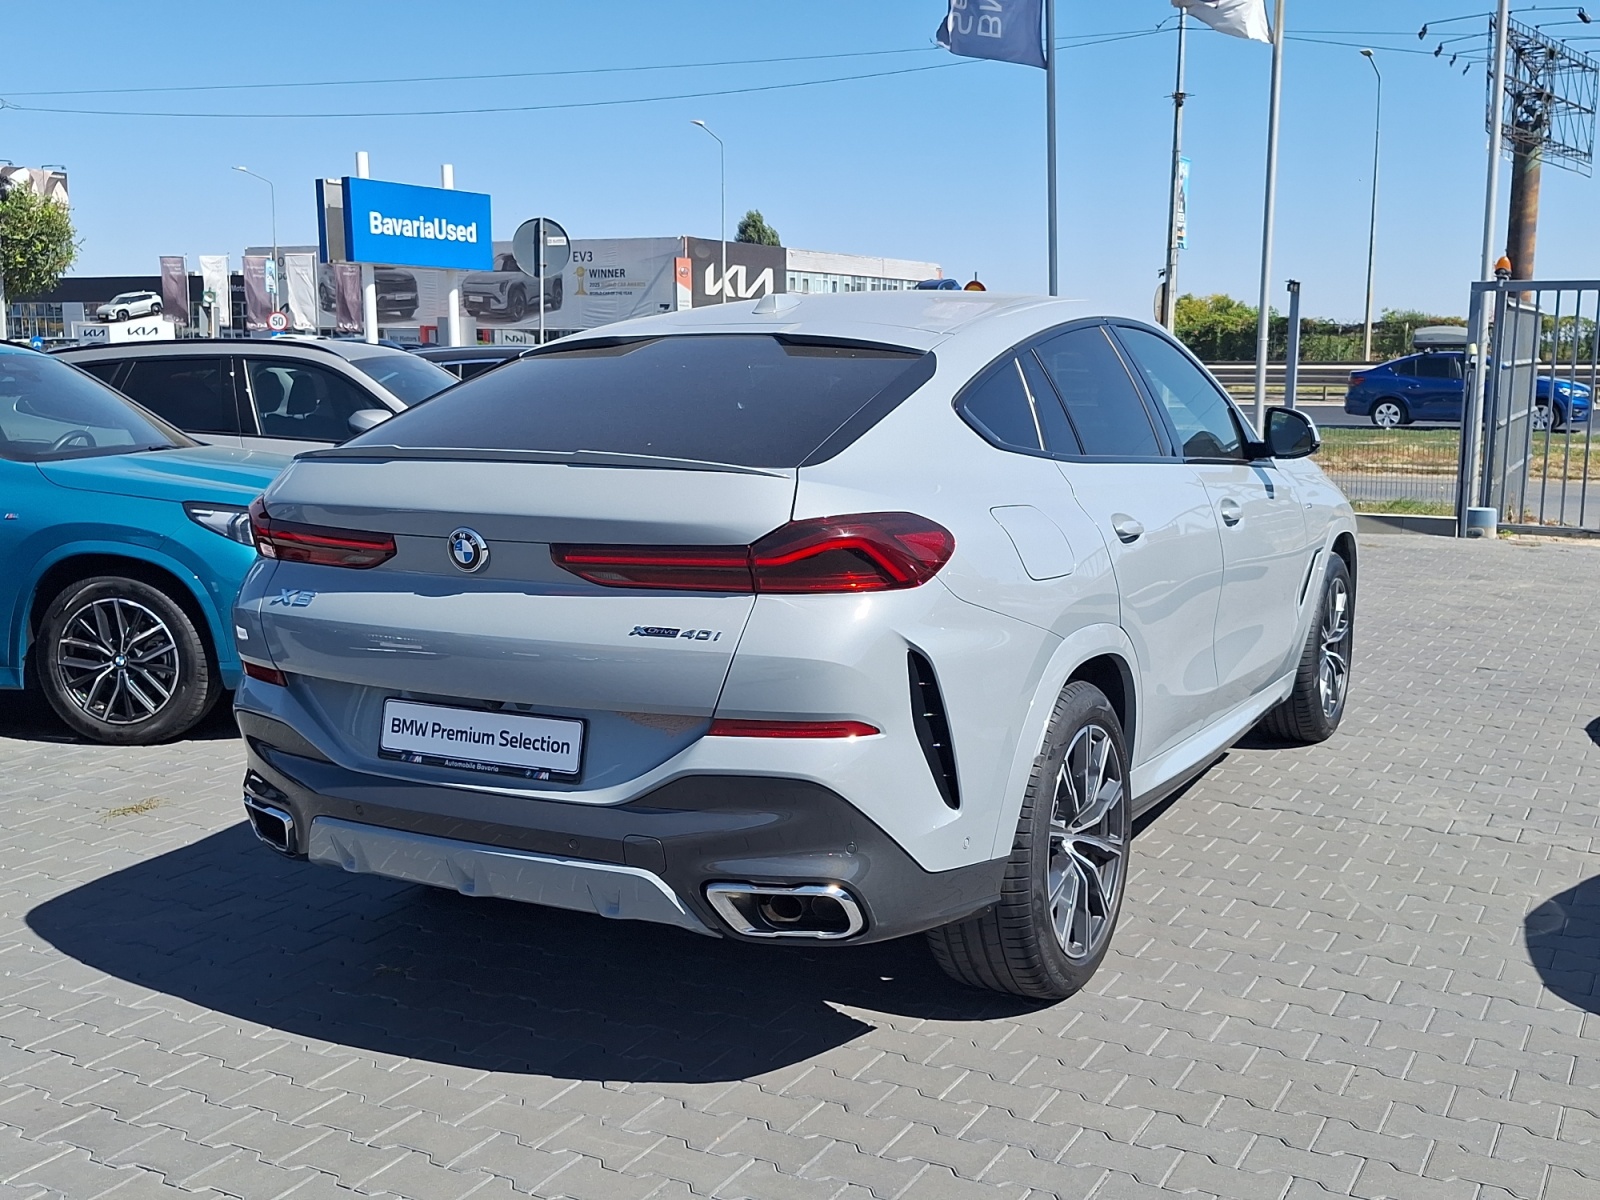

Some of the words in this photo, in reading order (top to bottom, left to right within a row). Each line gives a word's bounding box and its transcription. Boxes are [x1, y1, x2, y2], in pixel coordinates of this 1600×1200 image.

[368, 210, 478, 243] BavariaUsed
[572, 251, 593, 262] EV3
[588, 268, 626, 278] WINNER
[704, 262, 774, 299] KIA
[272, 317, 284, 326] 50
[84, 328, 105, 337] KIA
[127, 327, 159, 336] KIA
[269, 588, 318, 607] X6
[390, 717, 429, 737] BMW
[431, 722, 495, 746] Premium
[498, 729, 571, 755] Selection
[444, 759, 476, 770] Automobile
[476, 762, 499, 773] Bavaria
